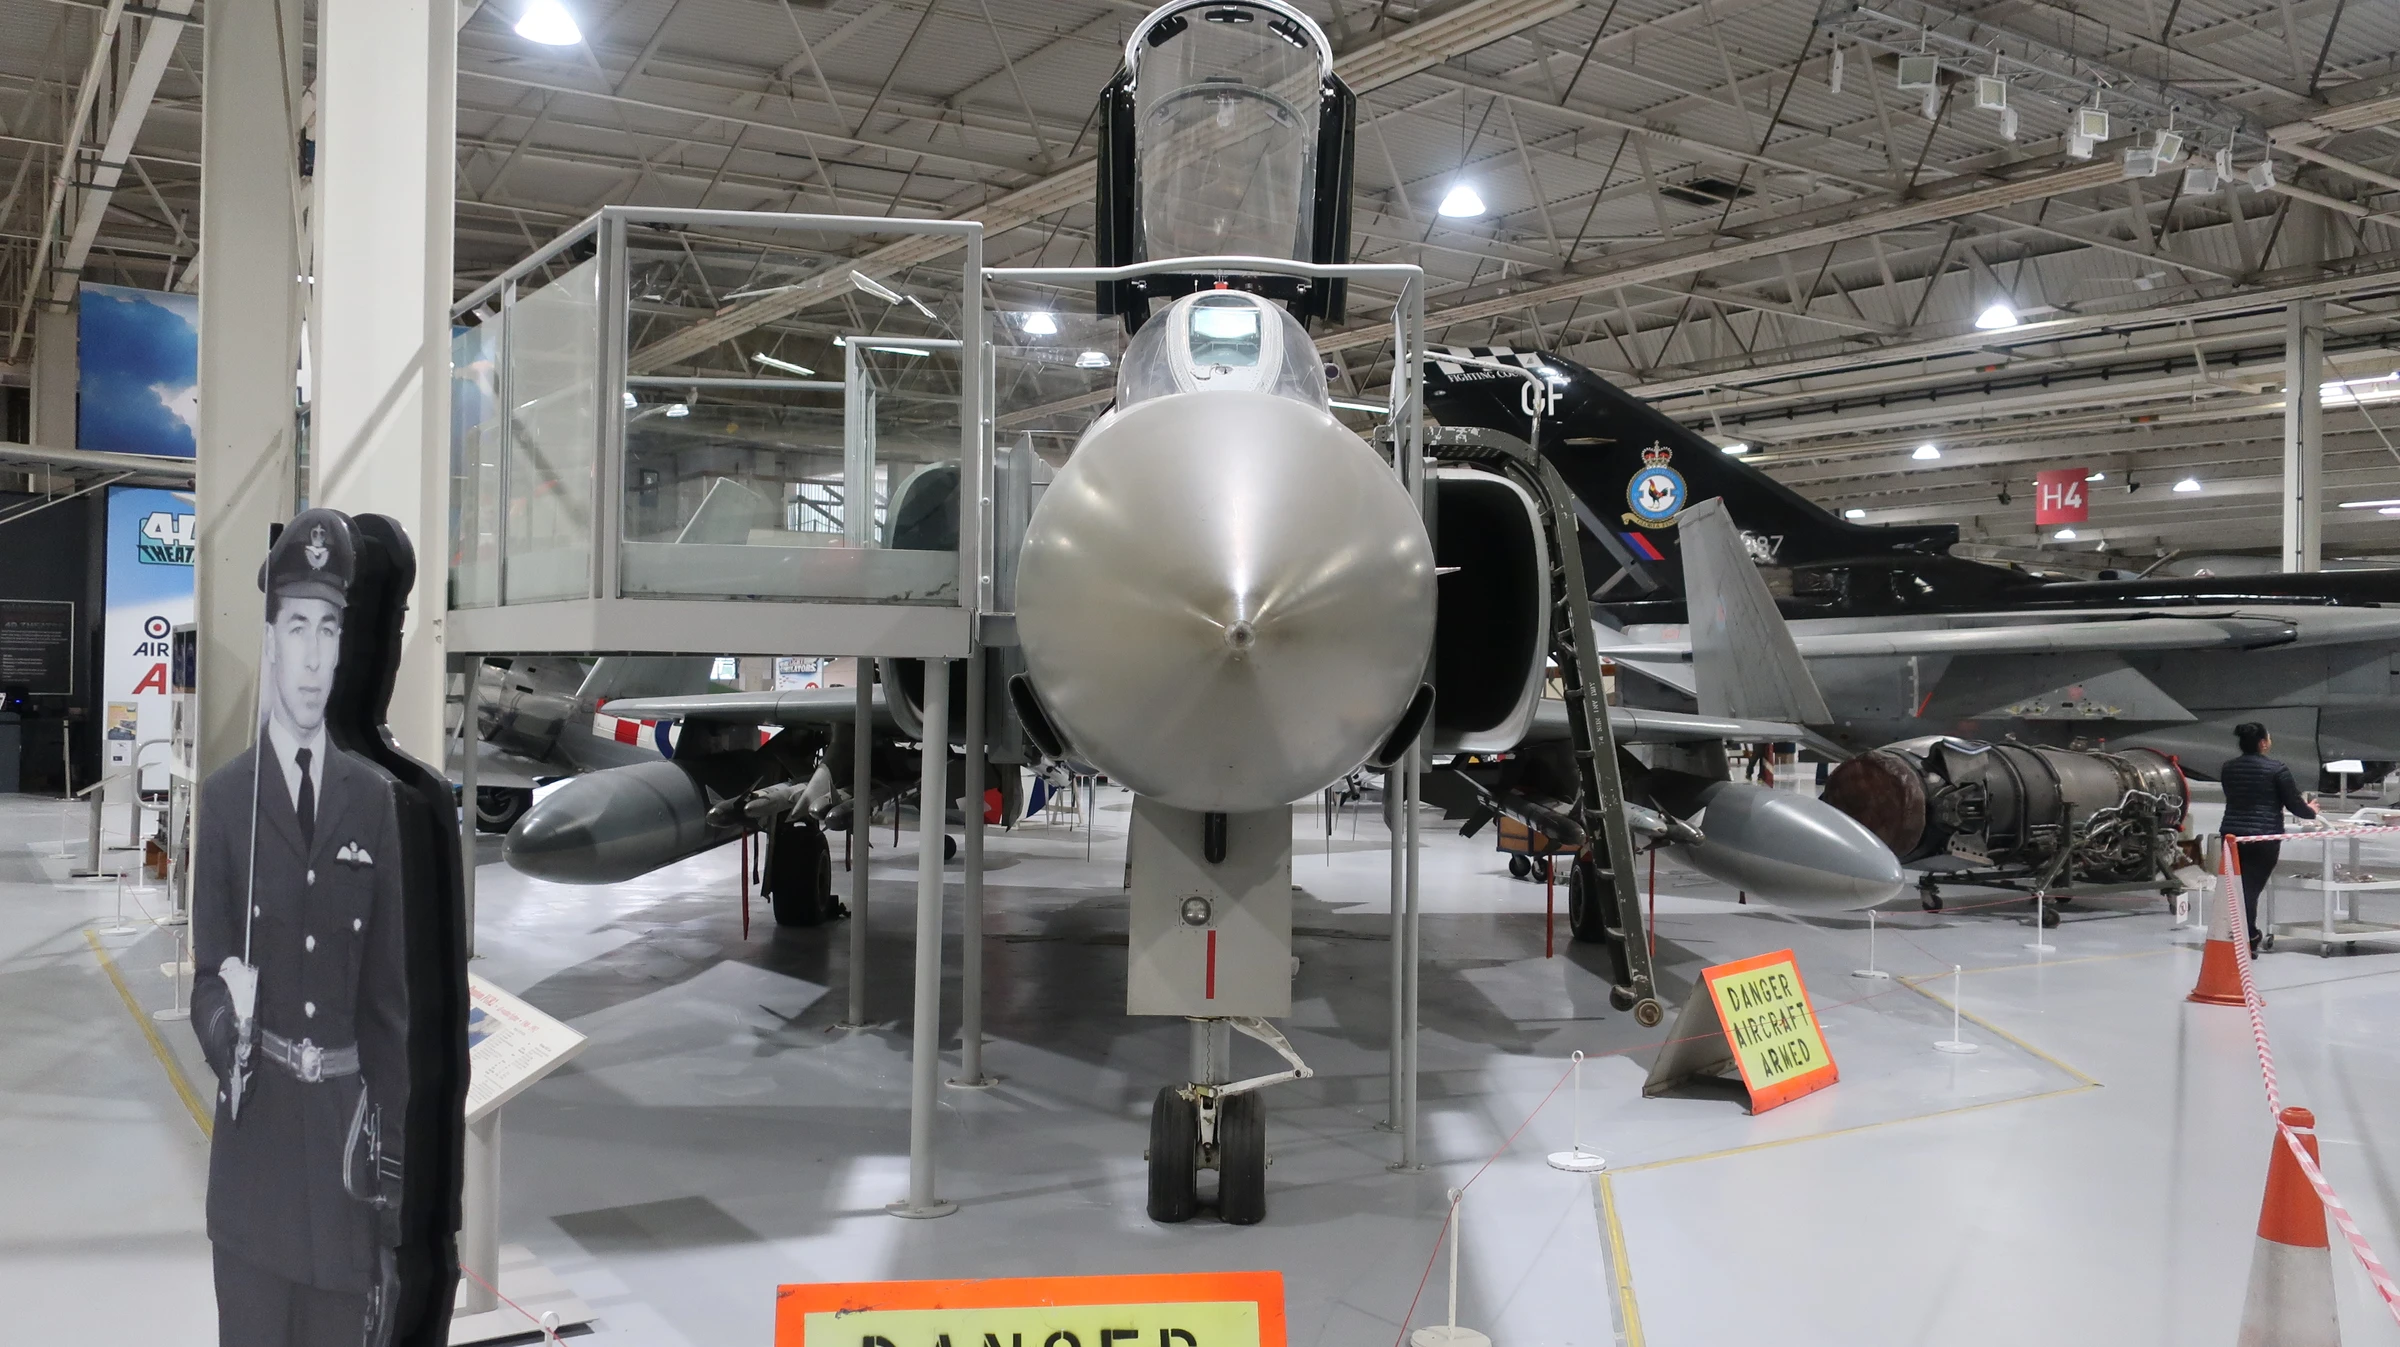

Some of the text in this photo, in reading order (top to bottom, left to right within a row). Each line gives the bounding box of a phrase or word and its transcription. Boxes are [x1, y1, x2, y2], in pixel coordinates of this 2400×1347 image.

[1447, 371, 1495, 383] FIGHTING
[2042, 481, 2082, 511] H4
[136, 545, 195, 563] THEAT
[1726, 973, 1793, 1012] DANGER
[1733, 1002, 1809, 1049] AIRCRAFT
[1760, 1038, 1811, 1078] ARMED
